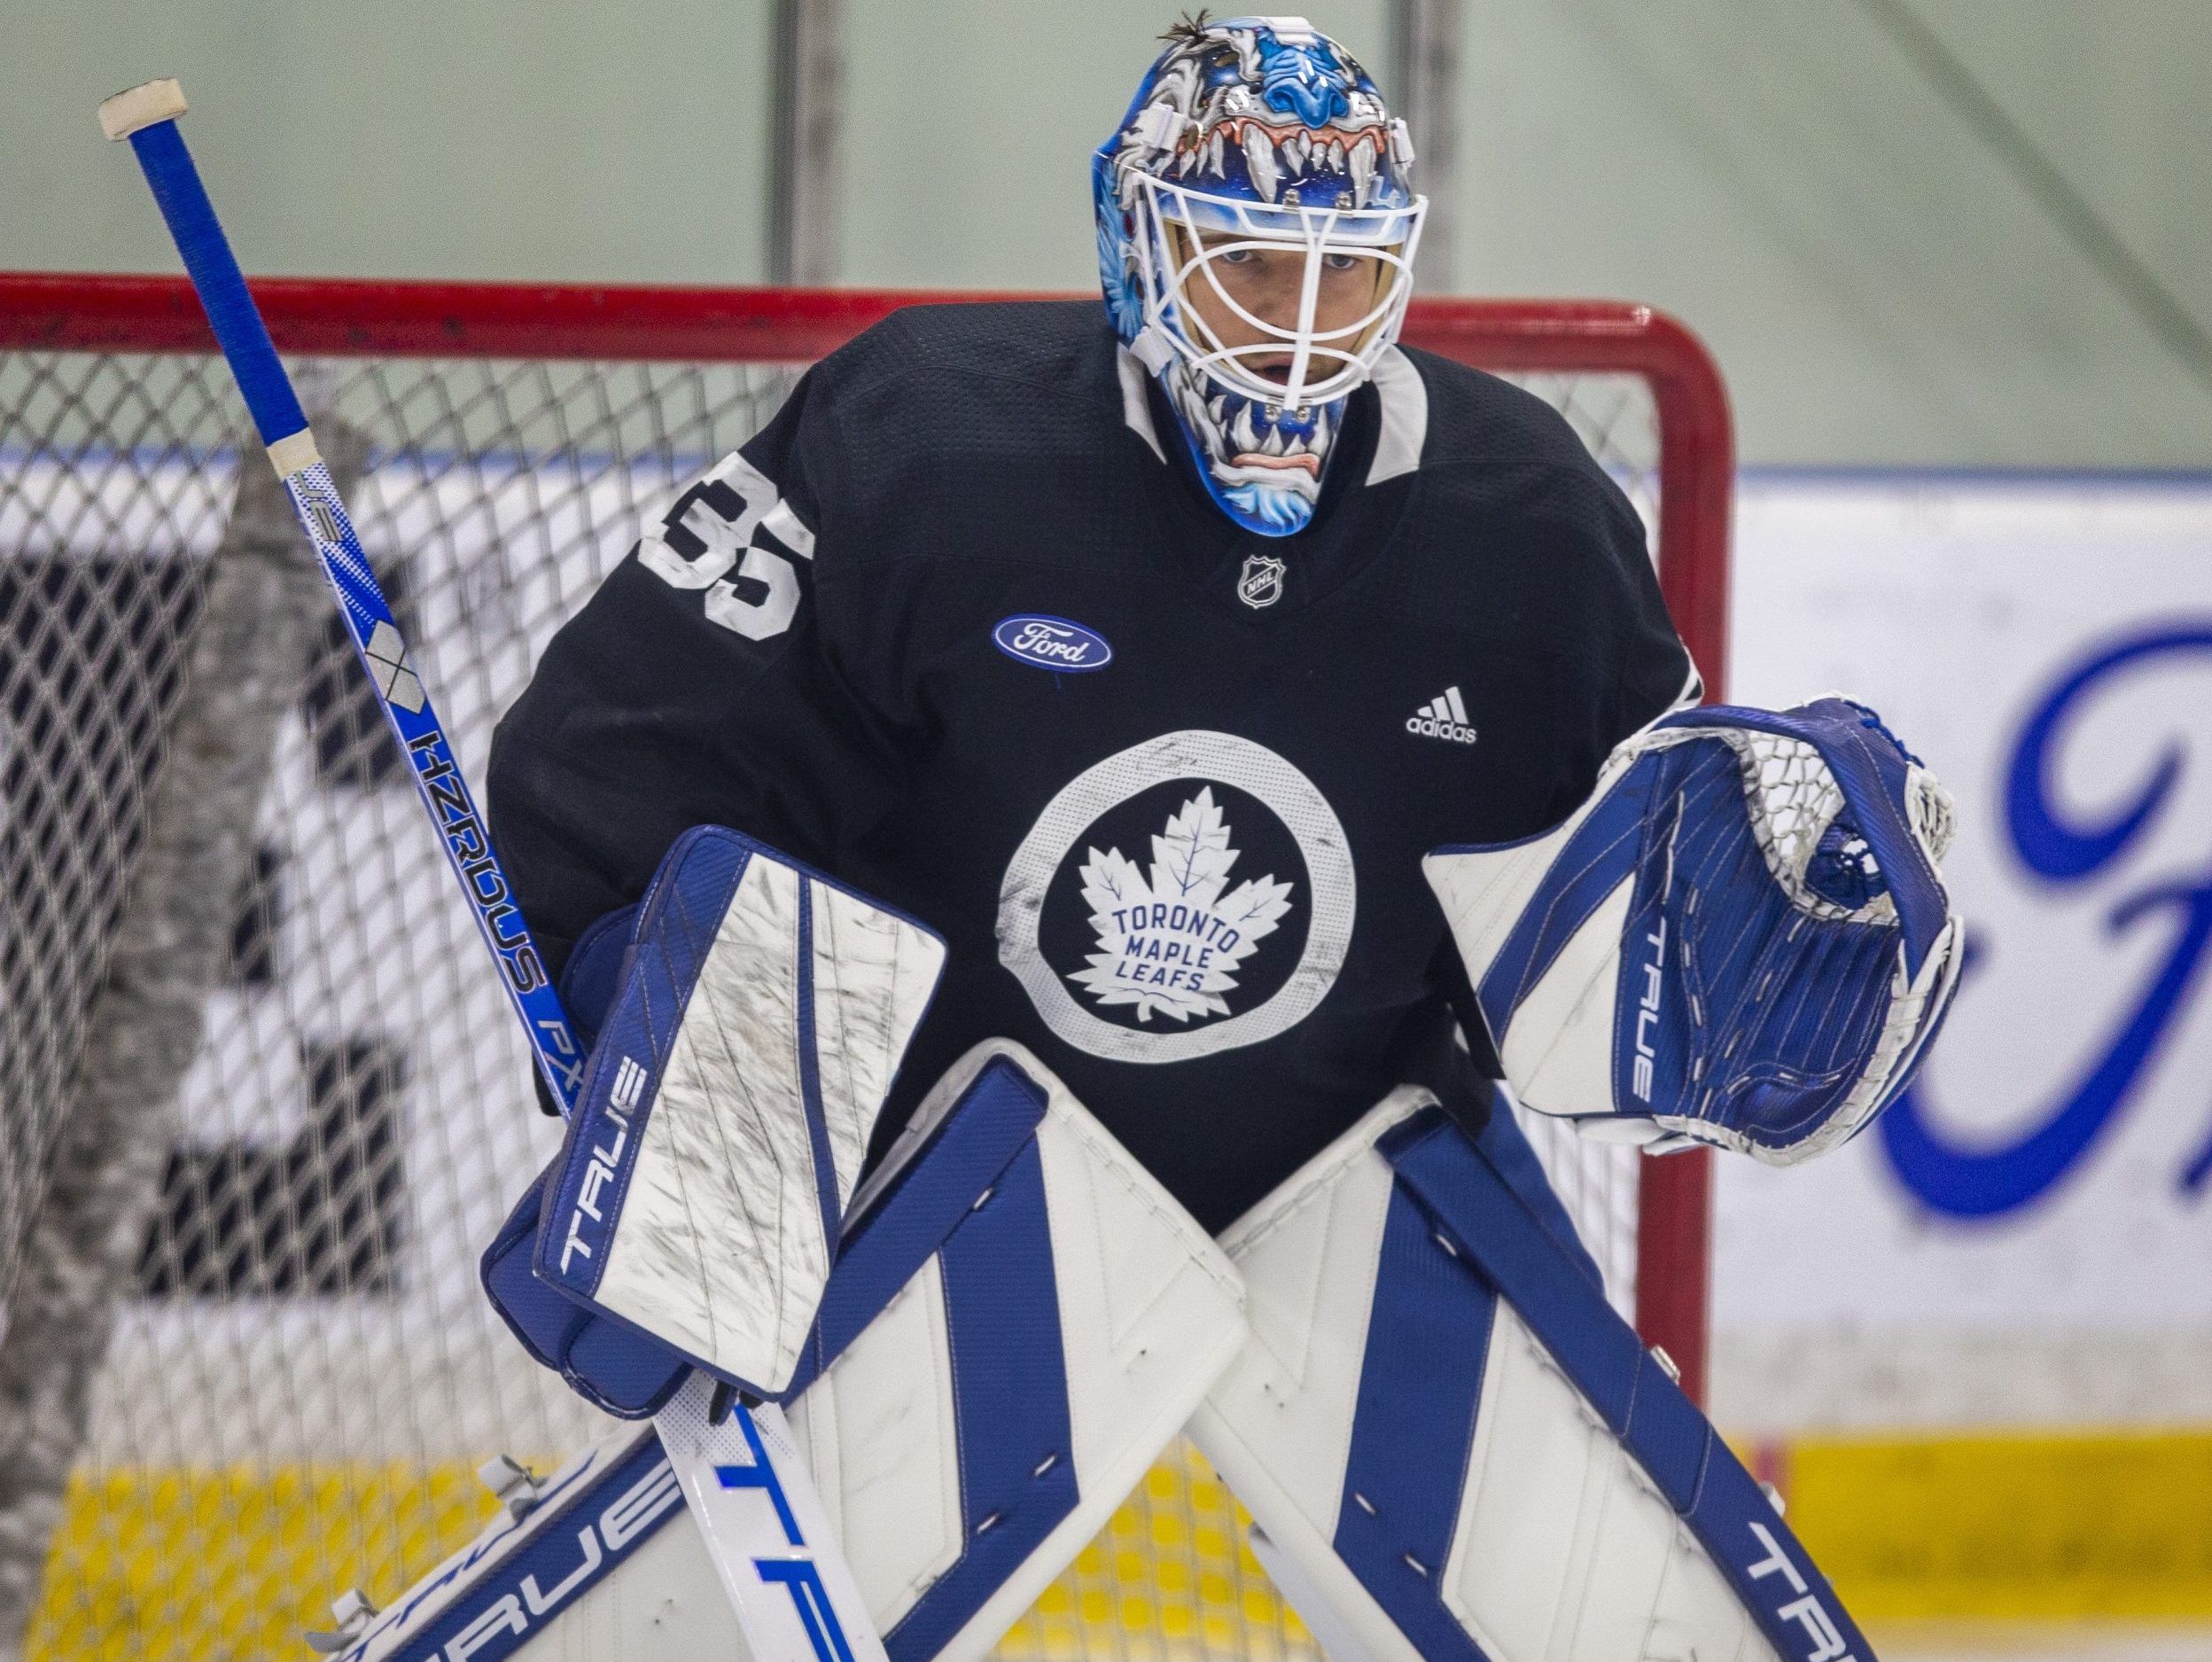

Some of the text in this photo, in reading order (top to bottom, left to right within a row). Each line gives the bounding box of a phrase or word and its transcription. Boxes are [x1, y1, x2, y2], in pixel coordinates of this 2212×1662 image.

[637, 450, 816, 642] 35
[1246, 571, 1274, 596] NHL
[1013, 622, 1091, 662] Ford
[1406, 717, 1477, 744] adidas
[408, 730, 549, 995] HZRDUS
[1111, 902, 1240, 954] TORONTO
[1115, 960, 1205, 992] LEAFS
[1125, 934, 1214, 970] MAPLE
[1632, 916, 1667, 1104] TRUE
[560, 1055, 648, 1276] TRUE
[425, 1456, 683, 1662] RUE
[1748, 1521, 1858, 1662] TR
